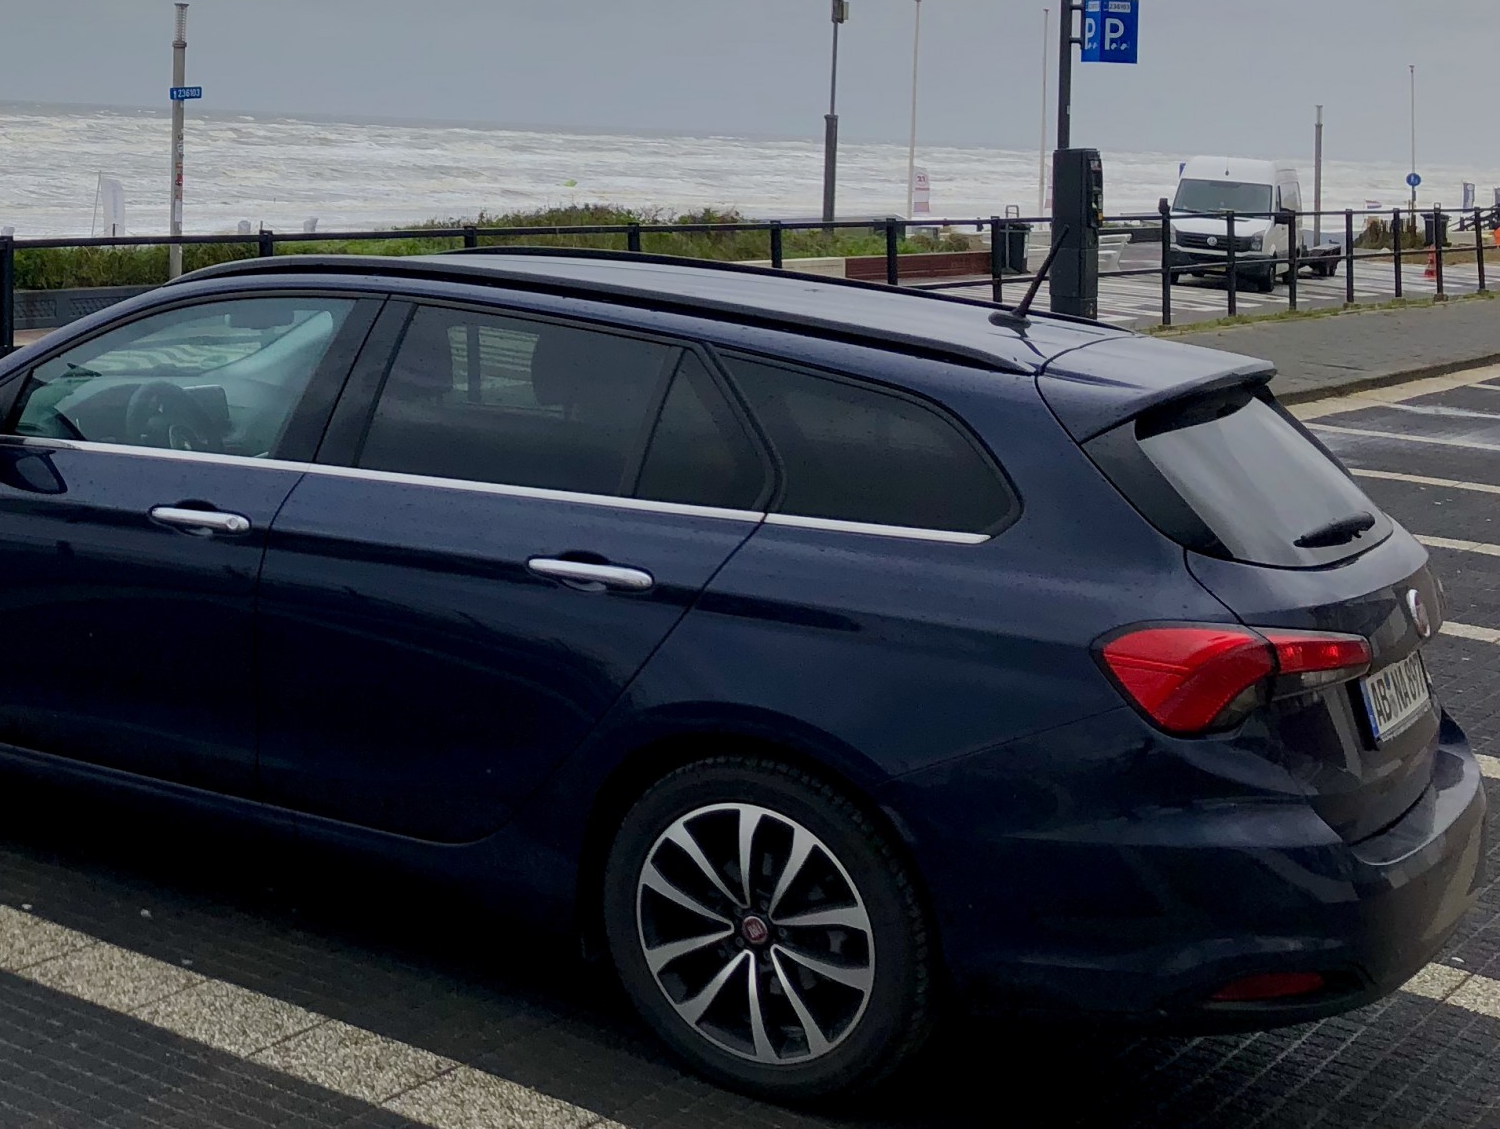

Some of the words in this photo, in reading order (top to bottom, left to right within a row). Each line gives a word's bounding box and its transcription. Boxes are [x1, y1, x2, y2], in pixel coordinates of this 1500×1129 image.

[1109, 3, 1130, 11] 236103
[1085, 17, 1096, 50] P
[1104, 17, 1124, 50] P
[177, 88, 200, 98] 236103
[1371, 678, 1391, 726] AB
